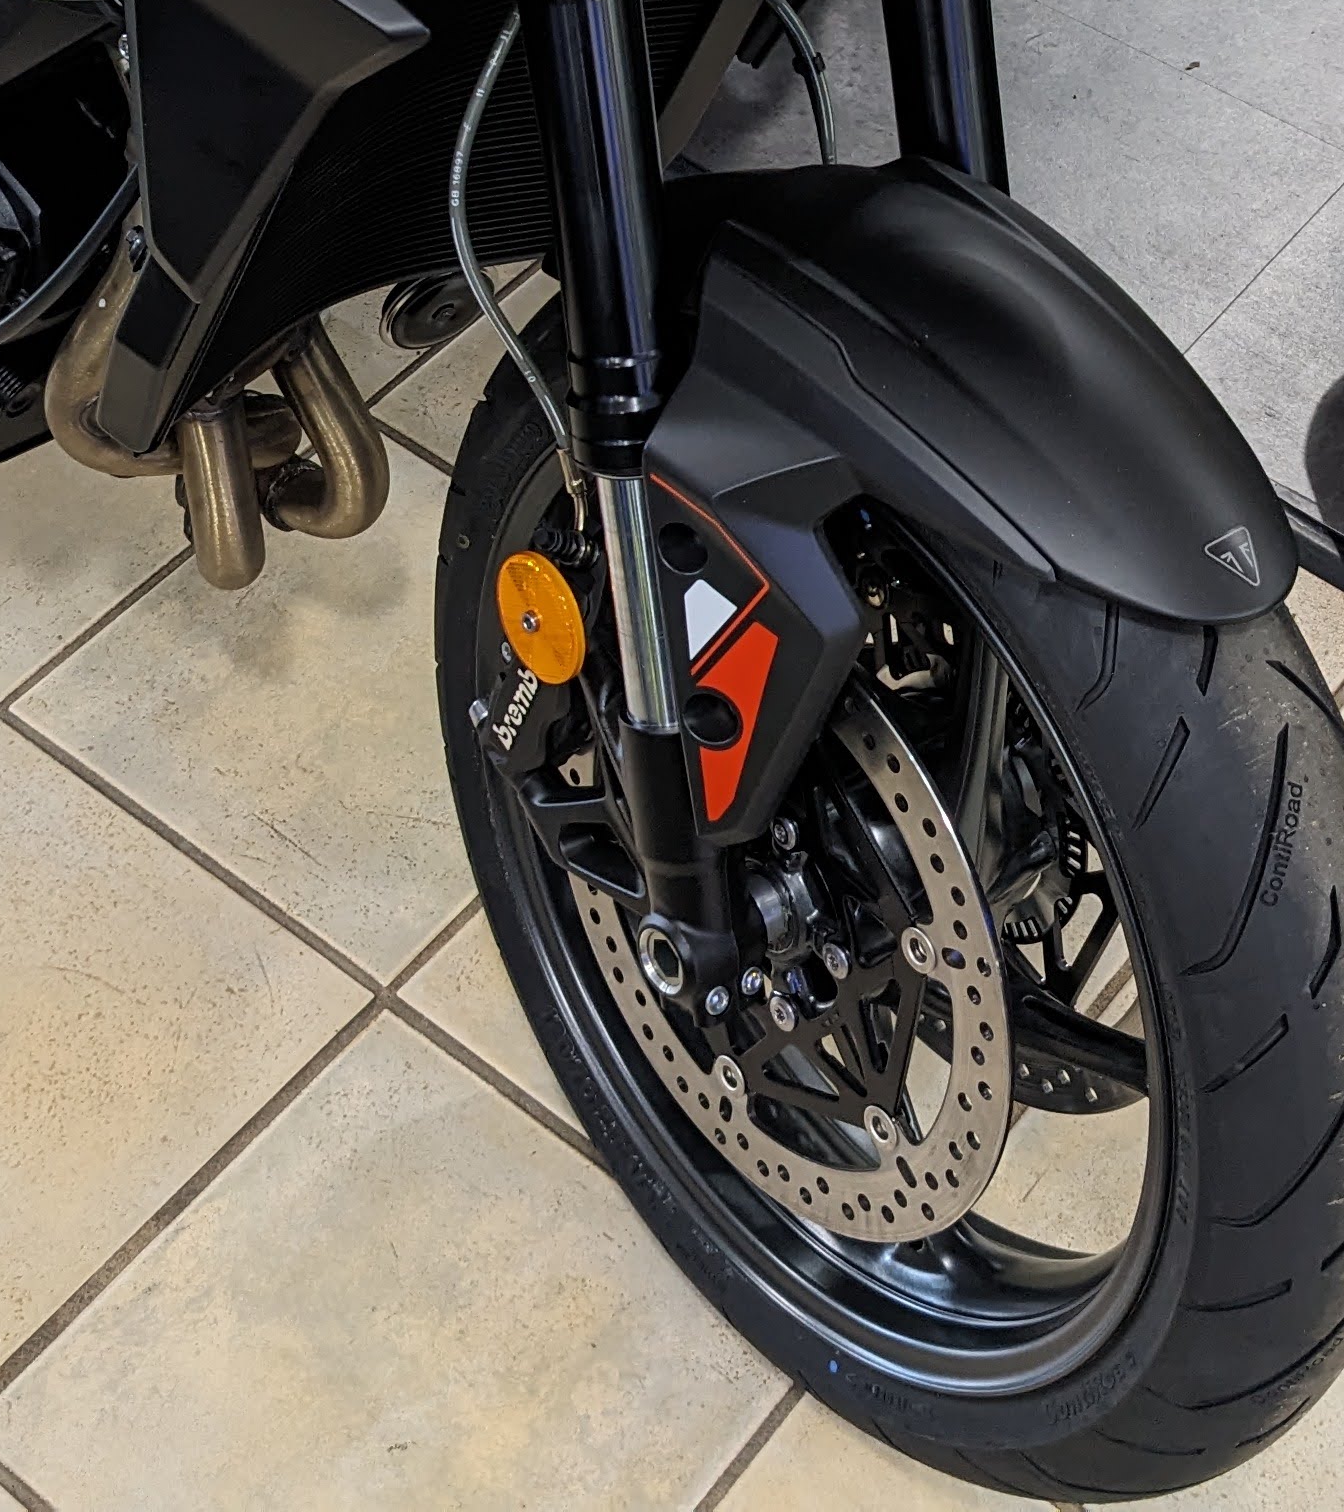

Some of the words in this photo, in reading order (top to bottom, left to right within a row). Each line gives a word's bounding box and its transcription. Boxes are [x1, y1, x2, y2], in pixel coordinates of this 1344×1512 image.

[452, 151, 464, 185] 16897
[451, 190, 460, 207] GB
[492, 667, 539, 751] bremb
[1259, 781, 1303, 908] ContiRoad
